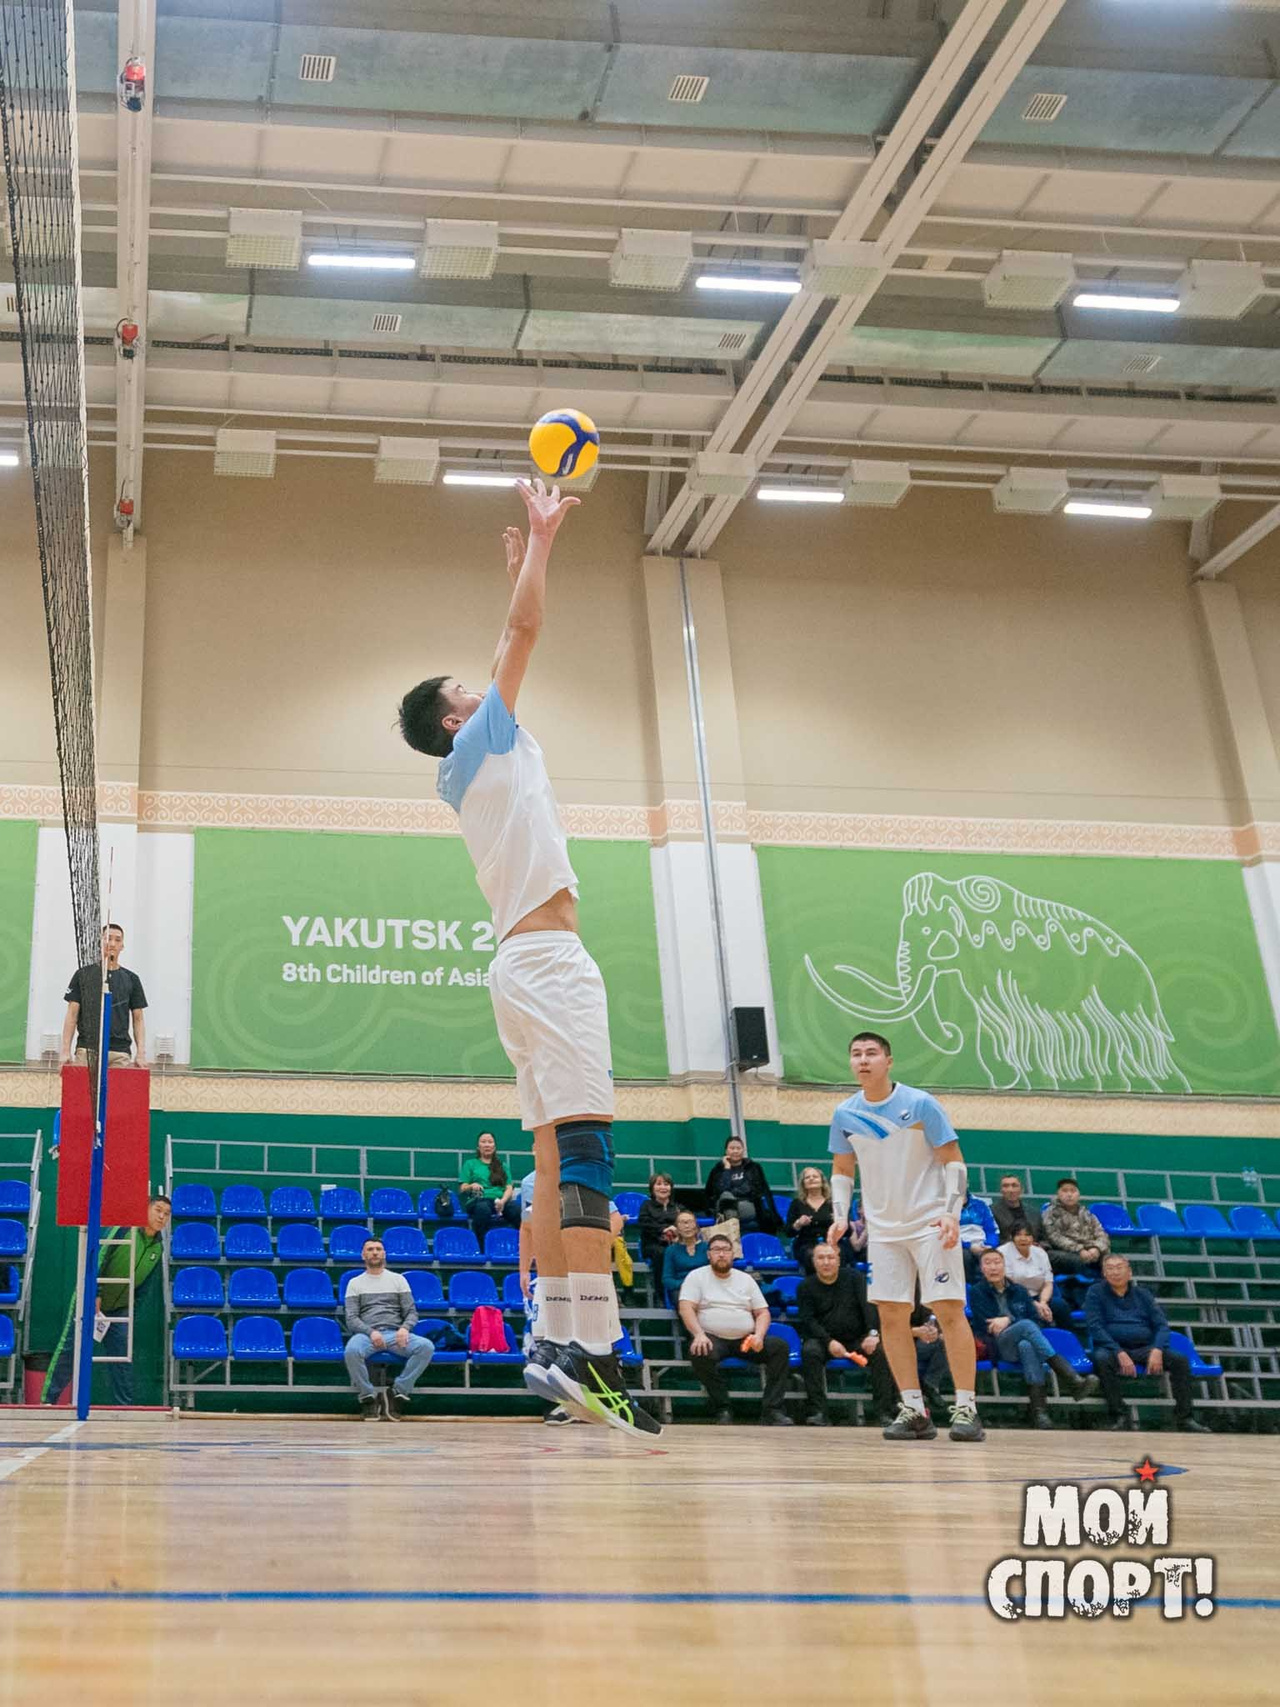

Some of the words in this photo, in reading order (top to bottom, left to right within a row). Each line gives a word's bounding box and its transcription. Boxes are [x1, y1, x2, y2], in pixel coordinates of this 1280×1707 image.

[281, 915, 463, 951] YAKUTSK
[282, 963, 321, 983] 8th
[326, 964, 417, 985] Children
[421, 967, 445, 986] of
